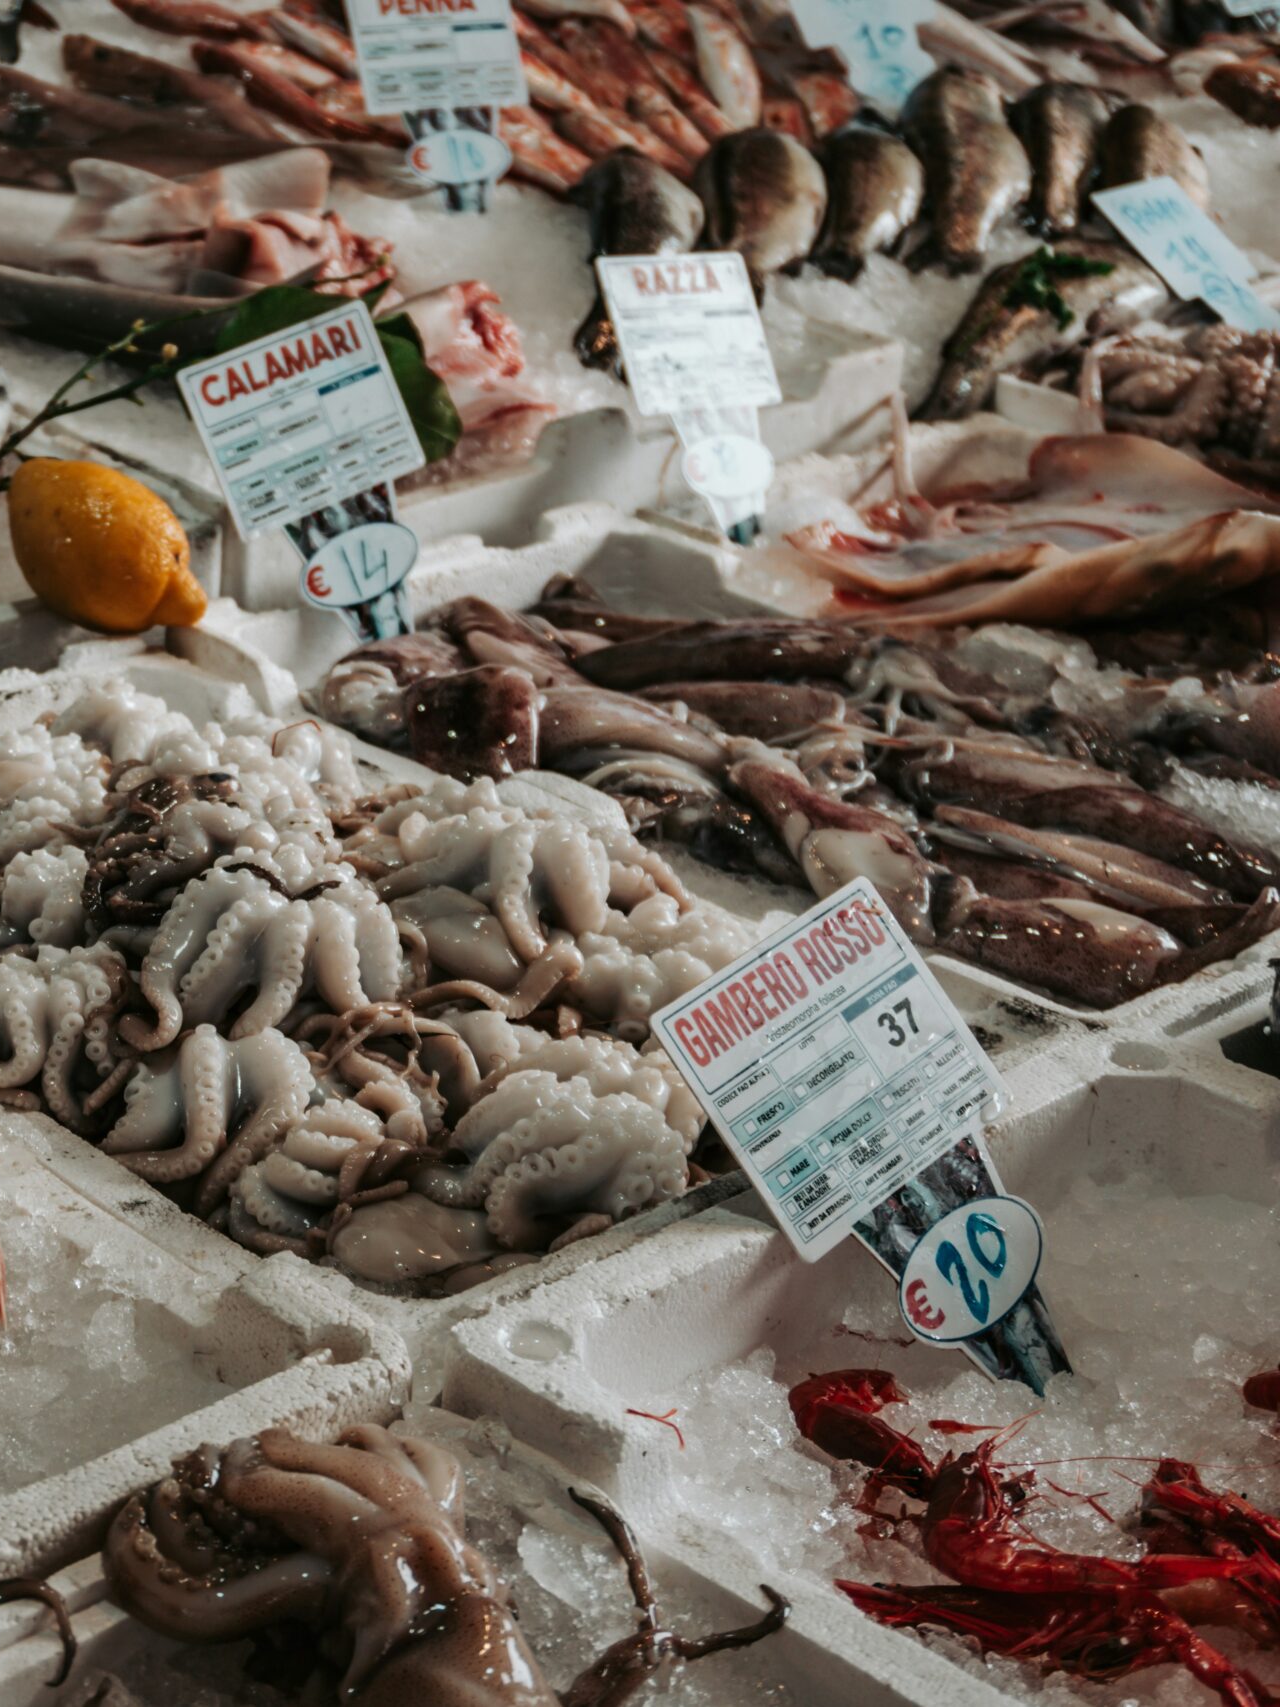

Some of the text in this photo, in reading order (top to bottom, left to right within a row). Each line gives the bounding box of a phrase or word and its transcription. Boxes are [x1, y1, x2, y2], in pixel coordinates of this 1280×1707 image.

[631, 263, 721, 297] RAZZA
[200, 319, 363, 407] CALAMARI
[306, 539, 389, 599] € 14
[674, 900, 884, 1066] GAMBERO ROSSO
[877, 997, 919, 1047] 37
[806, 1051, 855, 1089] DECONGELATO
[935, 1042, 965, 1068] ALLEVATO
[756, 1101, 785, 1125] FRESCO
[829, 1111, 872, 1146] ACQUA DOLCE
[789, 1158, 810, 1177] MARE
[905, 1212, 1007, 1330] € 20
